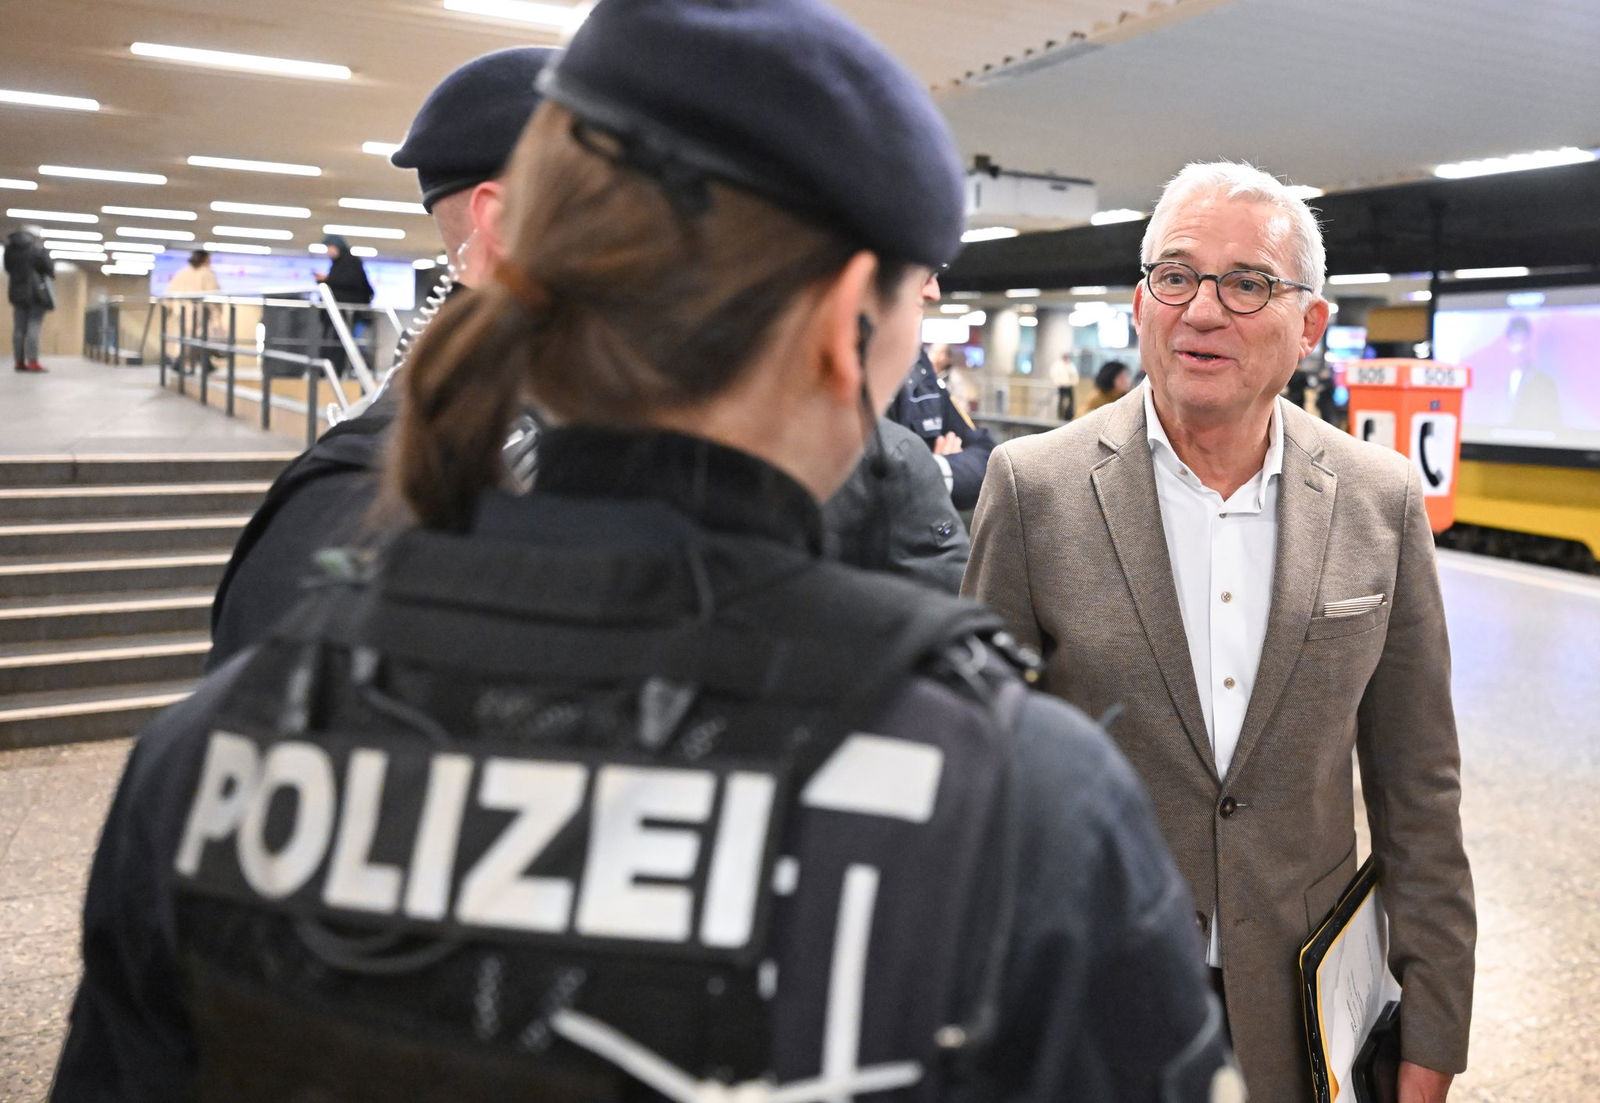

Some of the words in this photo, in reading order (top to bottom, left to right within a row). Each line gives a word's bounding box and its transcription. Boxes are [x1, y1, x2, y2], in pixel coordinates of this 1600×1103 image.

[1357, 366, 1386, 384] SOS
[1425, 367, 1456, 385] SOS
[175, 731, 777, 949] POLIZEI
